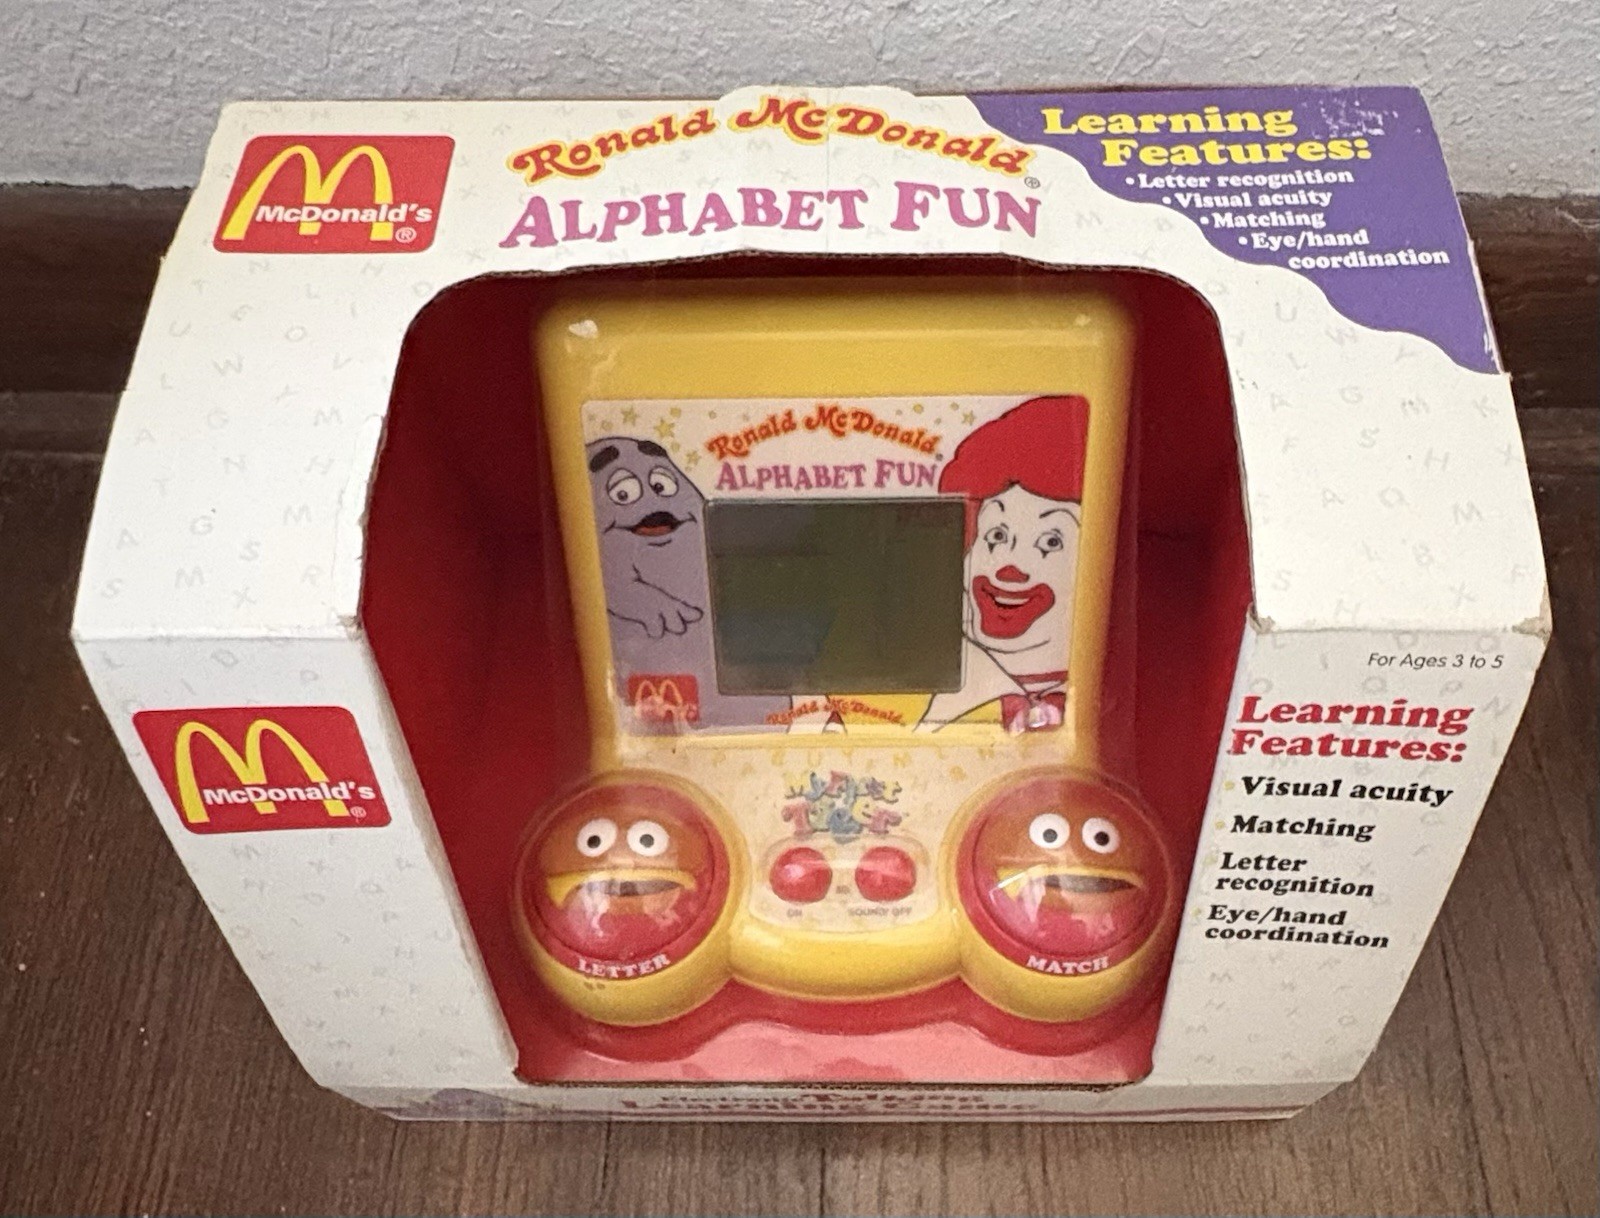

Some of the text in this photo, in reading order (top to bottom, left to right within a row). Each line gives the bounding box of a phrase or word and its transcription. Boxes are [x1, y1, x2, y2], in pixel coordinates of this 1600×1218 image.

[1042, 106, 1298, 138] Learning
[507, 96, 1037, 184] Ronald McDonald
[1101, 138, 1371, 167] Features:
[1138, 169, 1354, 189] Letter recognition
[1174, 189, 1332, 209] Visual acuity
[255, 203, 433, 223] McDonald's
[499, 181, 1041, 248] ALPHABET FUN
[1213, 211, 1326, 229] Matching
[1251, 230, 1369, 250] Eye/hand
[1288, 249, 1450, 270] coordination
[705, 403, 941, 460] Ronald McDonald
[715, 459, 938, 490] ALPHABET FUN
[1368, 653, 1504, 670] For Ages 3 to 5
[1237, 695, 1475, 735] Learning
[1226, 728, 1467, 762] Features:
[202, 781, 376, 806] McDonald's
[1241, 776, 1453, 807] Visual acuity
[1230, 815, 1376, 842] Matching
[1220, 852, 1307, 872] Letter
[1215, 875, 1374, 897] recognition
[1207, 904, 1347, 926] Eye/hand
[1205, 926, 1389, 948] coordination
[578, 953, 671, 978] LETTER
[1026, 954, 1109, 975] MATCH
